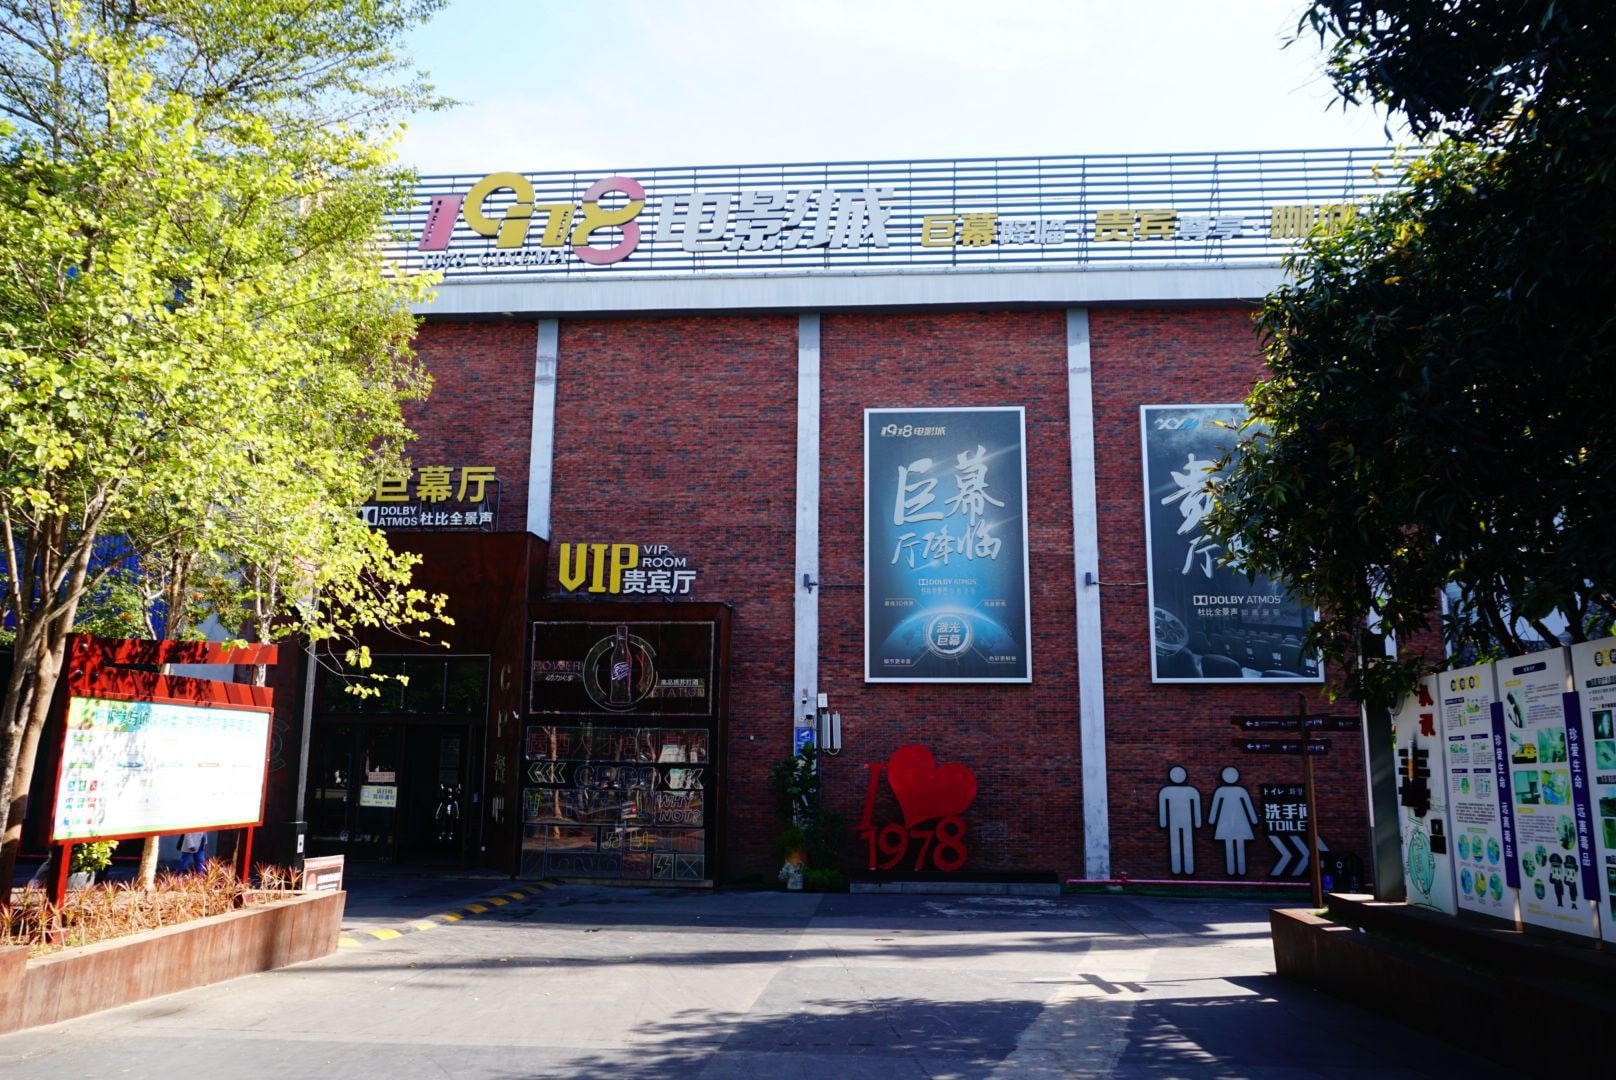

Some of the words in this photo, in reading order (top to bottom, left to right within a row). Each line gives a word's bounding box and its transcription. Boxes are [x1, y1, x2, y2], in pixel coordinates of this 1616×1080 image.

[655, 186, 895, 253] 电影城
[477, 249, 568, 269] CINEMA
[375, 465, 497, 504] 巨幕厅
[894, 445, 1006, 527] 巨幕
[380, 506, 418, 516] DOLBY
[378, 517, 419, 527] ATMOS
[419, 511, 495, 527] 杜比全景声
[642, 544, 669, 555] VIP
[558, 542, 640, 595] VIP
[641, 556, 687, 568] ROOM
[622, 569, 697, 595] 贵宾厅
[1209, 595, 1245, 605] DOLBY
[1246, 595, 1281, 604] ATMOS
[1263, 787, 1285, 796] トイレ
[658, 795, 692, 808] WHY
[659, 809, 702, 823] NOT?
[858, 815, 969, 872] 1978
